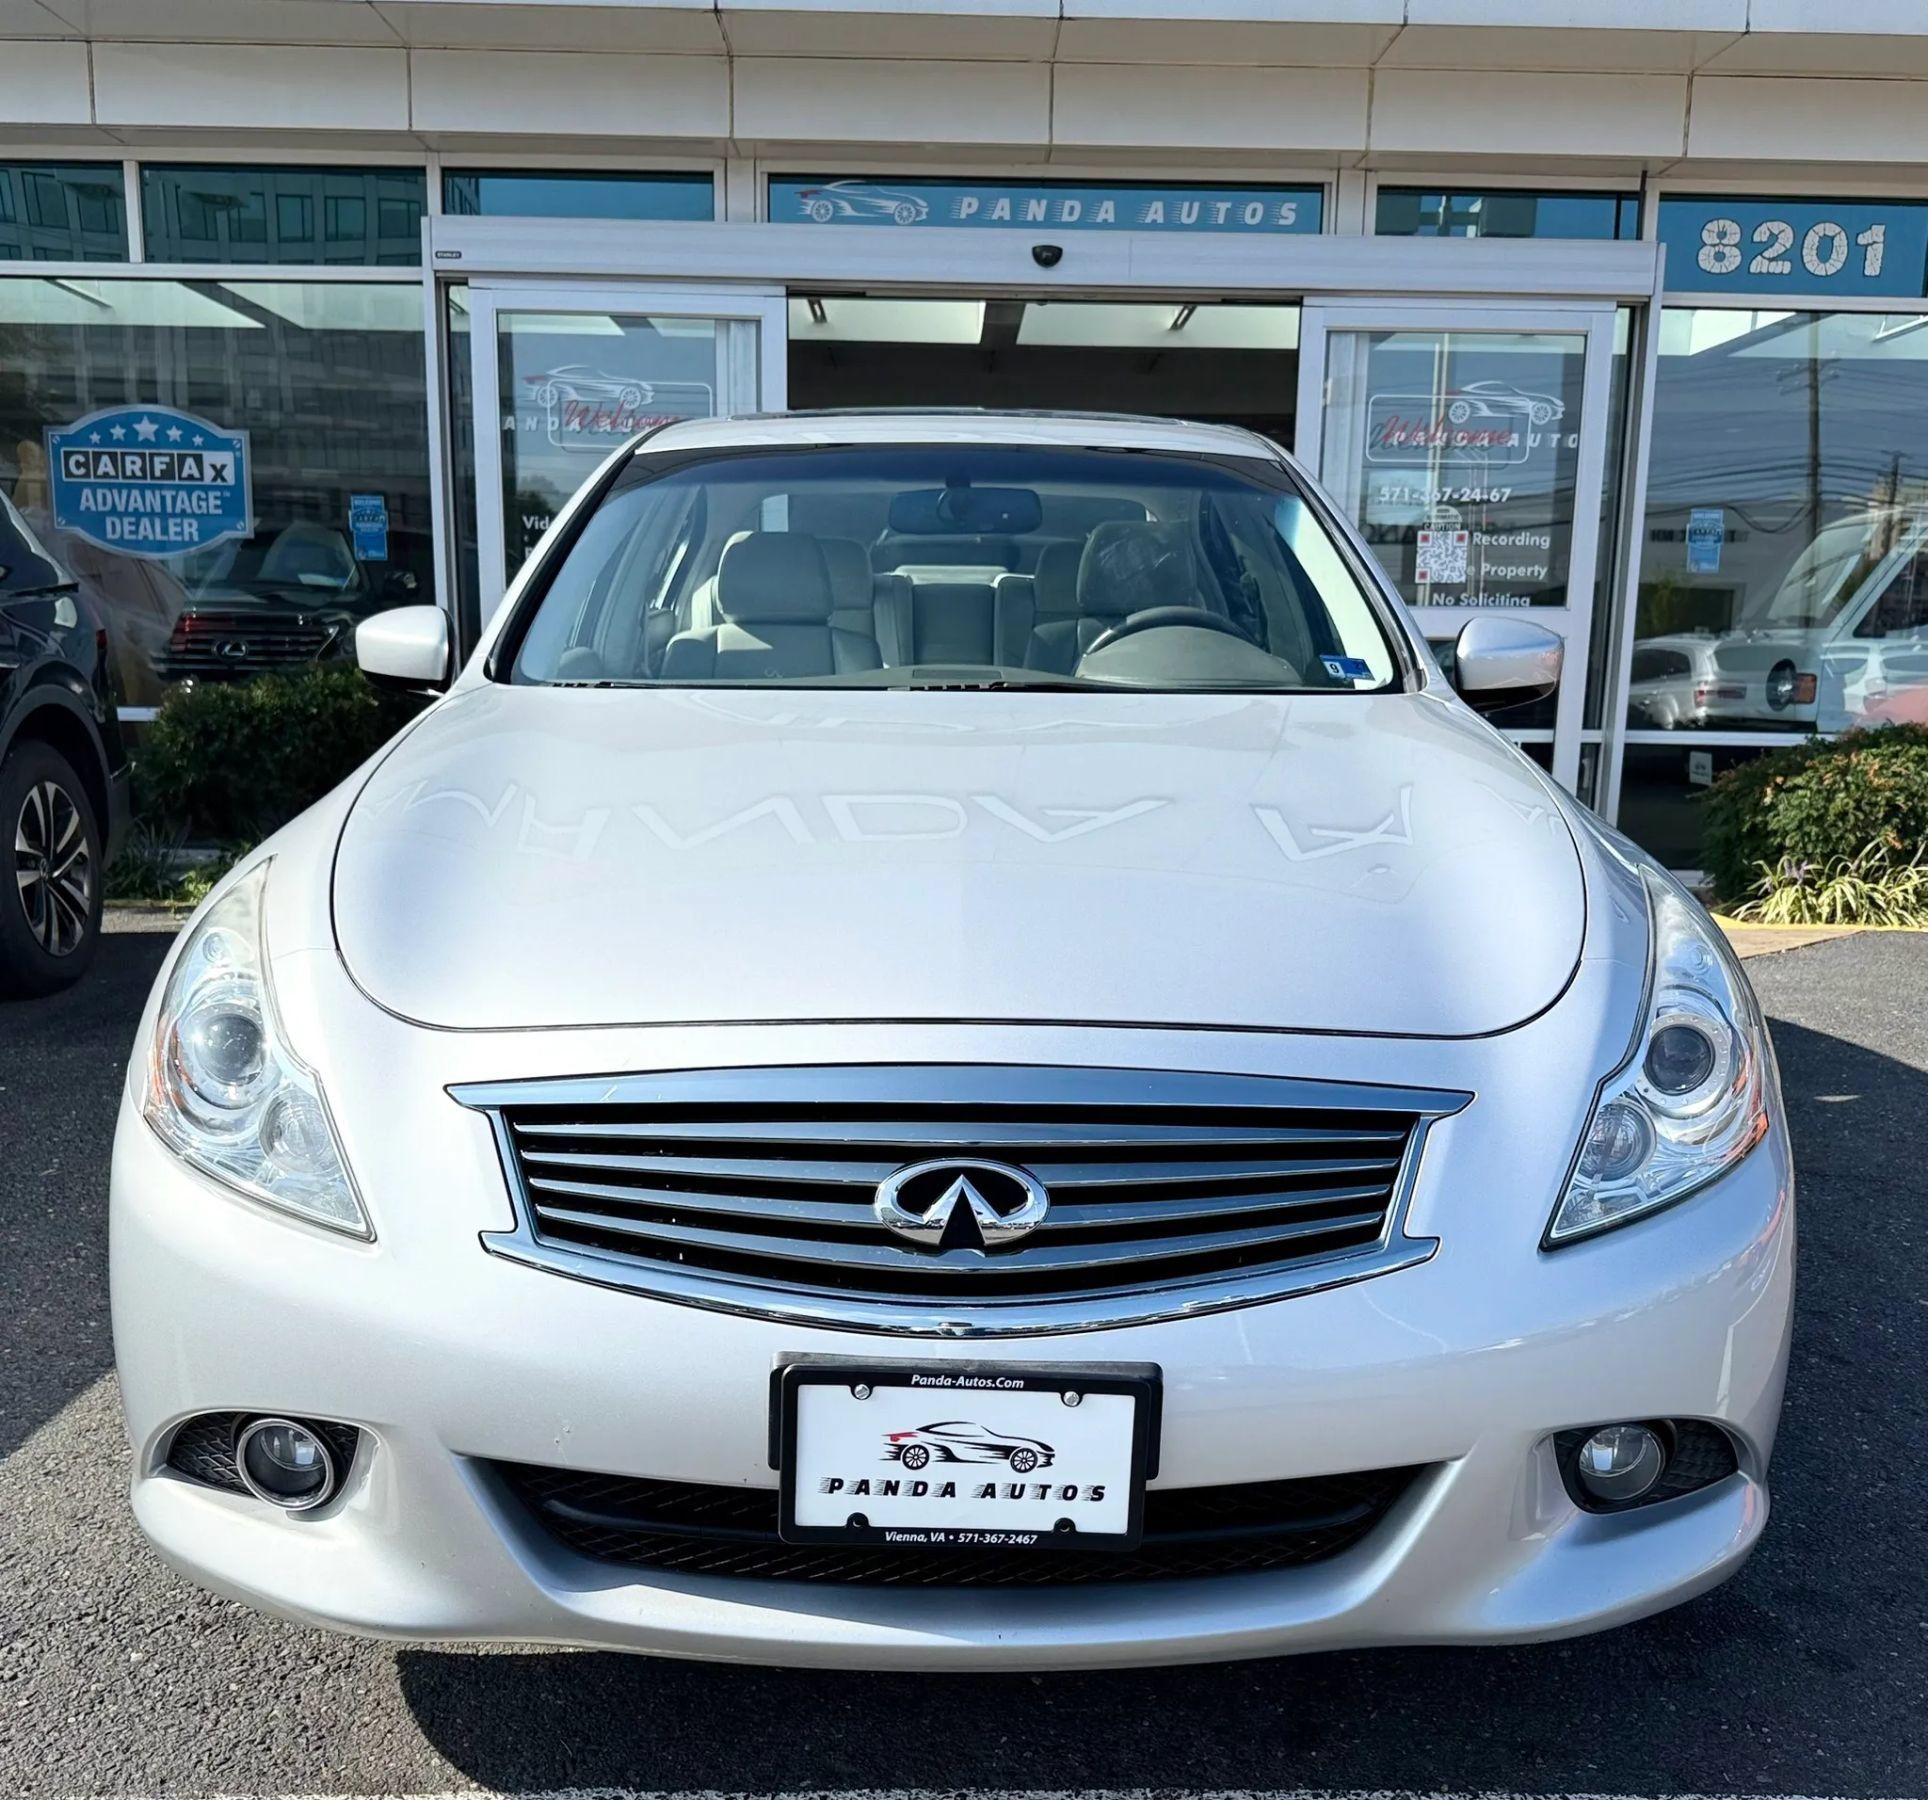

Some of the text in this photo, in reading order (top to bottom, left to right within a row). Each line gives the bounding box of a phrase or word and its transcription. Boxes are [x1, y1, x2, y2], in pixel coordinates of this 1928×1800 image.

[952, 196, 1298, 226] PANDA AUTOS
[1697, 218, 1886, 277] 8201
[501, 415, 581, 432] ANDA
[1507, 432, 1578, 448] AUTO
[68, 453, 229, 484] CARFAX
[105, 517, 199, 542] DEALER
[1472, 532, 1551, 549] Recording
[1481, 563, 1548, 580] Property
[1433, 591, 1531, 607] No Soliciting
[911, 1374, 1025, 1389] Panda-Autos.Com
[817, 1476, 1106, 1502] PANDA AUTOS
[885, 1531, 1038, 1545] Vienna, VA 571-367-2467
